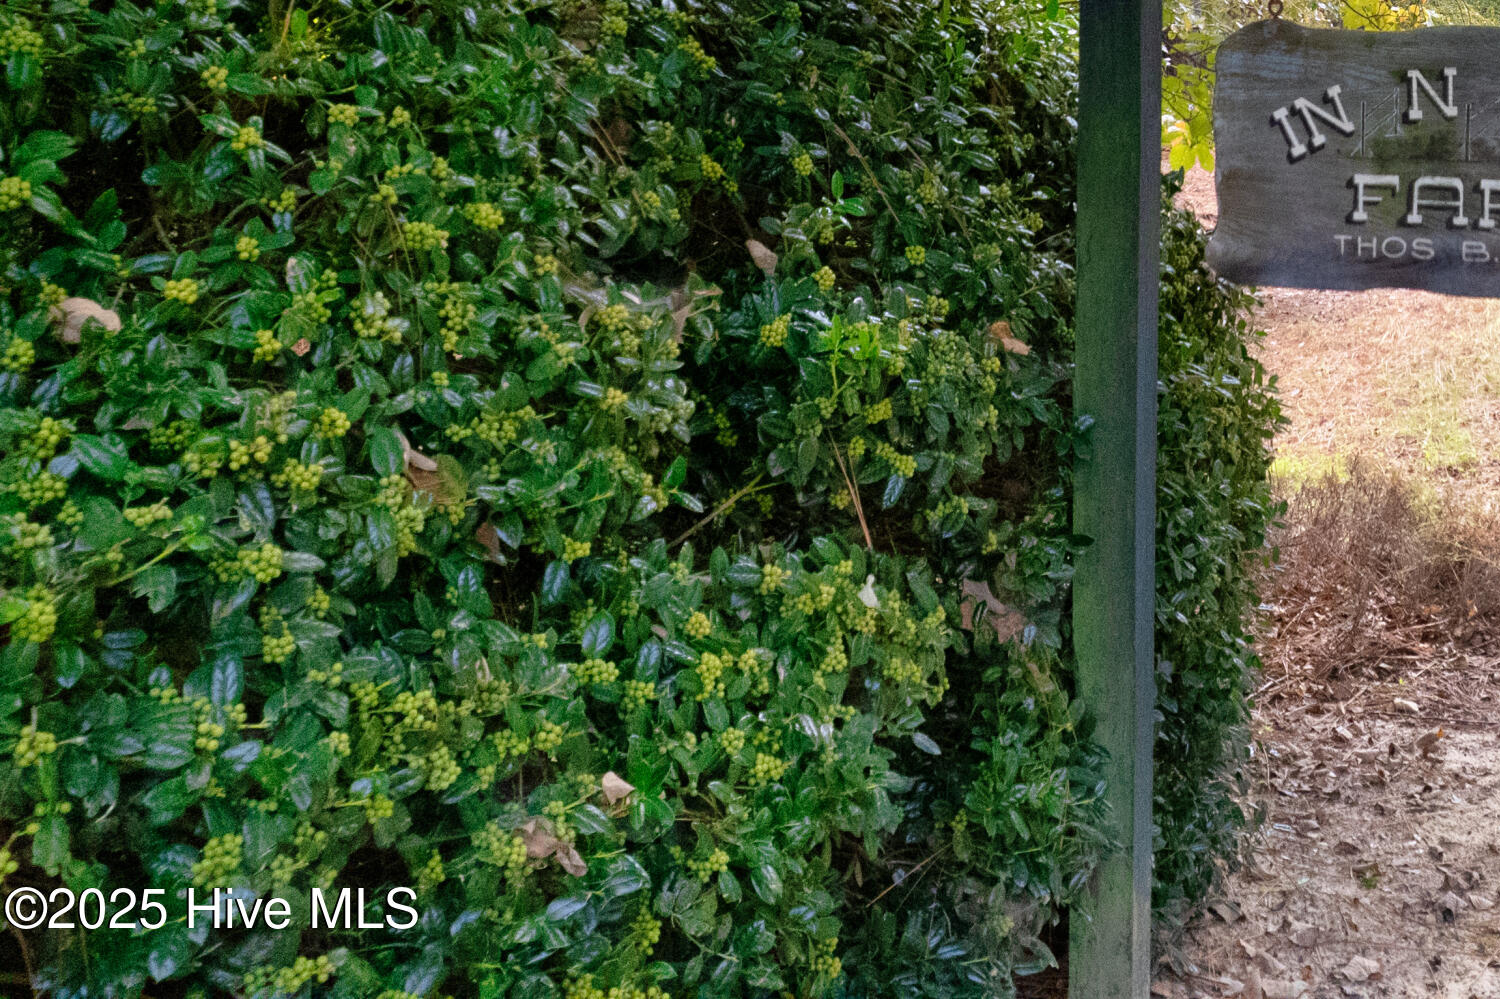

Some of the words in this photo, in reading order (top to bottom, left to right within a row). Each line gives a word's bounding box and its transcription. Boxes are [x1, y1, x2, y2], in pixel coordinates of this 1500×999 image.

[1273, 85, 1355, 161] IN
[1407, 66, 1459, 122] N
[1334, 235, 1435, 259] THOS
[1461, 242, 1499, 263] B.
